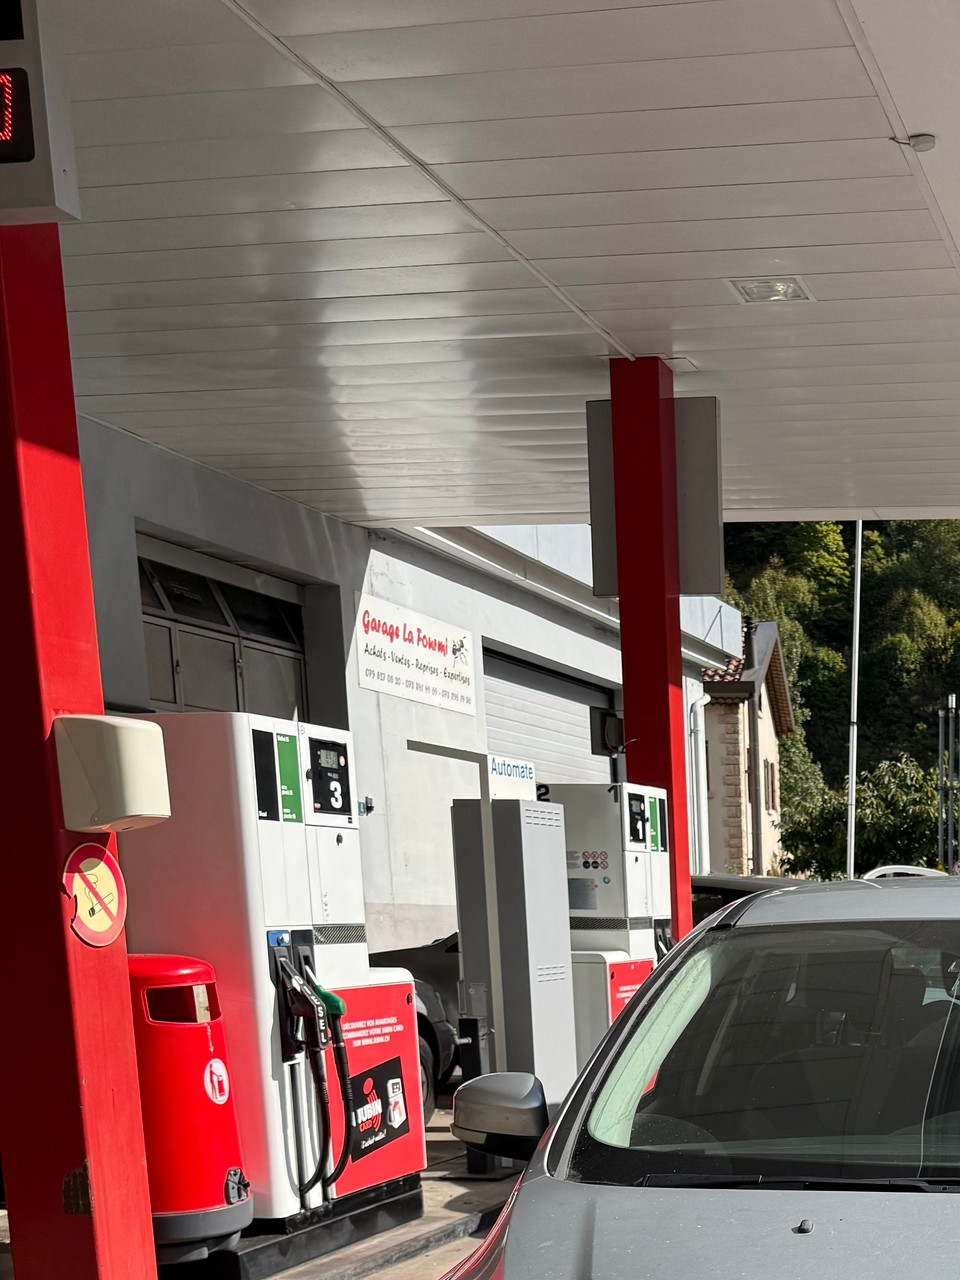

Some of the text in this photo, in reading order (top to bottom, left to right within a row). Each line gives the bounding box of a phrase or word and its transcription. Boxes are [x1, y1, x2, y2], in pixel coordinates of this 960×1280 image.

[363, 610, 448, 657] Garage La Fourmi
[364, 643, 387, 661] Achats
[391, 651, 410, 668] Ventes
[415, 658, 439, 677] Reprises
[443, 667, 470, 685] Expertises
[491, 757, 534, 780] Automate
[329, 780, 343, 809] 3
[537, 784, 550, 802] 2
[607, 785, 619, 803] 1
[636, 820, 643, 840] 1
[294, 975, 327, 1043] DIESEL
[356, 1099, 383, 1124] JUBIN
[359, 1119, 373, 1132] CARD
